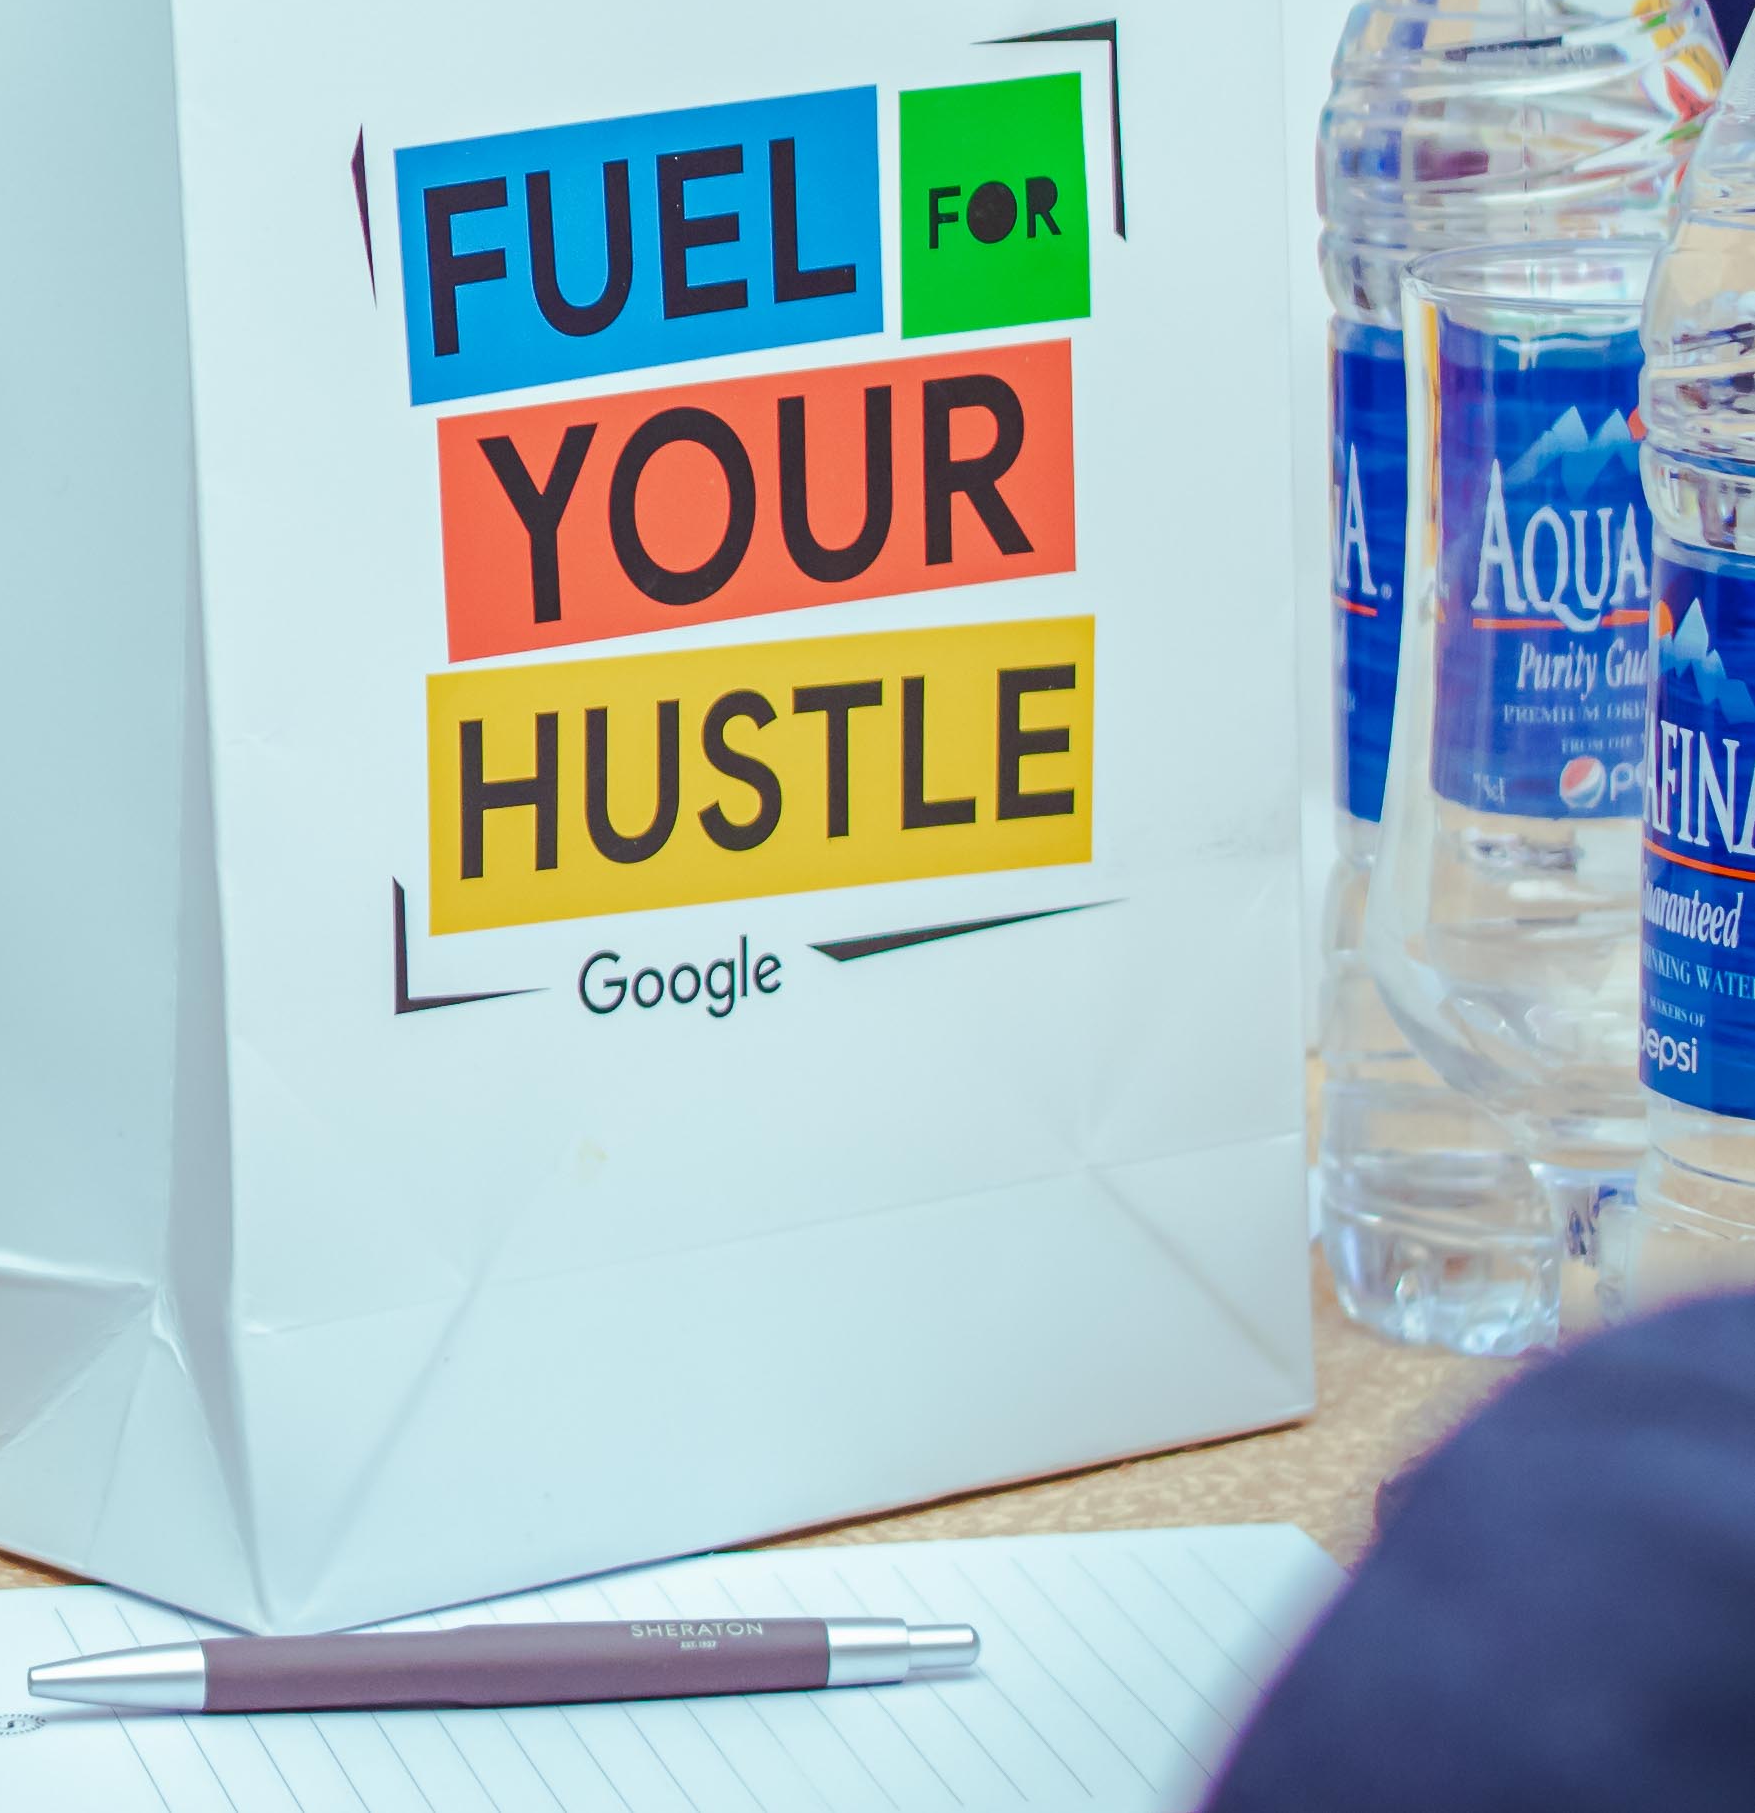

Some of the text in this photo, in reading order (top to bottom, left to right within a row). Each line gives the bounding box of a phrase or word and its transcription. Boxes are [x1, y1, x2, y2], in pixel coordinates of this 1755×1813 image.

[421, 136, 1061, 358] FUEL FOR
[476, 373, 1034, 624] YOUR
[1516, 641, 1597, 701] Purity
[457, 662, 1077, 880] HUSTLE
[577, 933, 783, 1018] Google
[1696, 964, 1755, 1000] WATE
[631, 1621, 764, 1638] SHERATON
